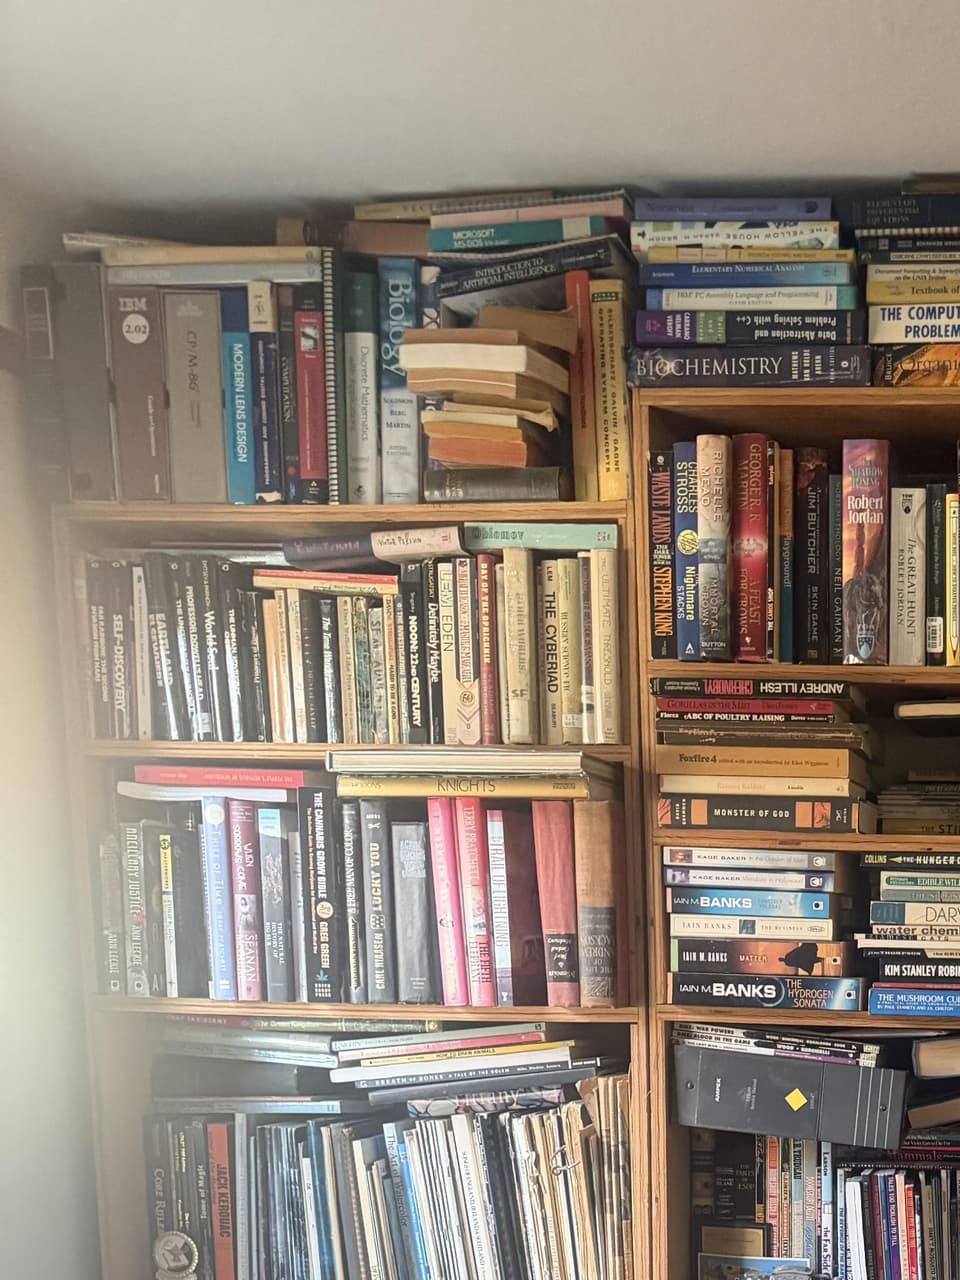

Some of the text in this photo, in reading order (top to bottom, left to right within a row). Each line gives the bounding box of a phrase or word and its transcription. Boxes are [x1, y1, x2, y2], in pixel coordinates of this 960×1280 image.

[453, 229, 496, 240] MICROSOFT
[119, 298, 147, 312] IBM
[880, 307, 902, 321] THE
[124, 324, 148, 334] 2.02
[636, 357, 784, 376] BIOCHEMISTRY
[232, 343, 247, 462] MODERN LENS DESIGN
[848, 495, 884, 510] Robert
[848, 510, 884, 524] Jordan
[441, 616, 453, 651] EDEN
[544, 592, 558, 693] THE CYBERIAD
[113, 614, 126, 712] SELF-DISCOVERY
[437, 779, 496, 793] KNIGHTS
[714, 809, 790, 818] MONSTER OF GOD
[876, 926, 917, 935] water
[885, 965, 900, 976] KIM
[902, 965, 936, 977] STANLEY
[679, 983, 776, 998] IAIN M. BANKS
[785, 979, 802, 989] THE
[787, 989, 834, 999] HYDROGEN
[897, 995, 944, 1003] MUSHROOM
[793, 999, 827, 1008] SONATA
[216, 1162, 231, 1239] JACK KEROUAC
